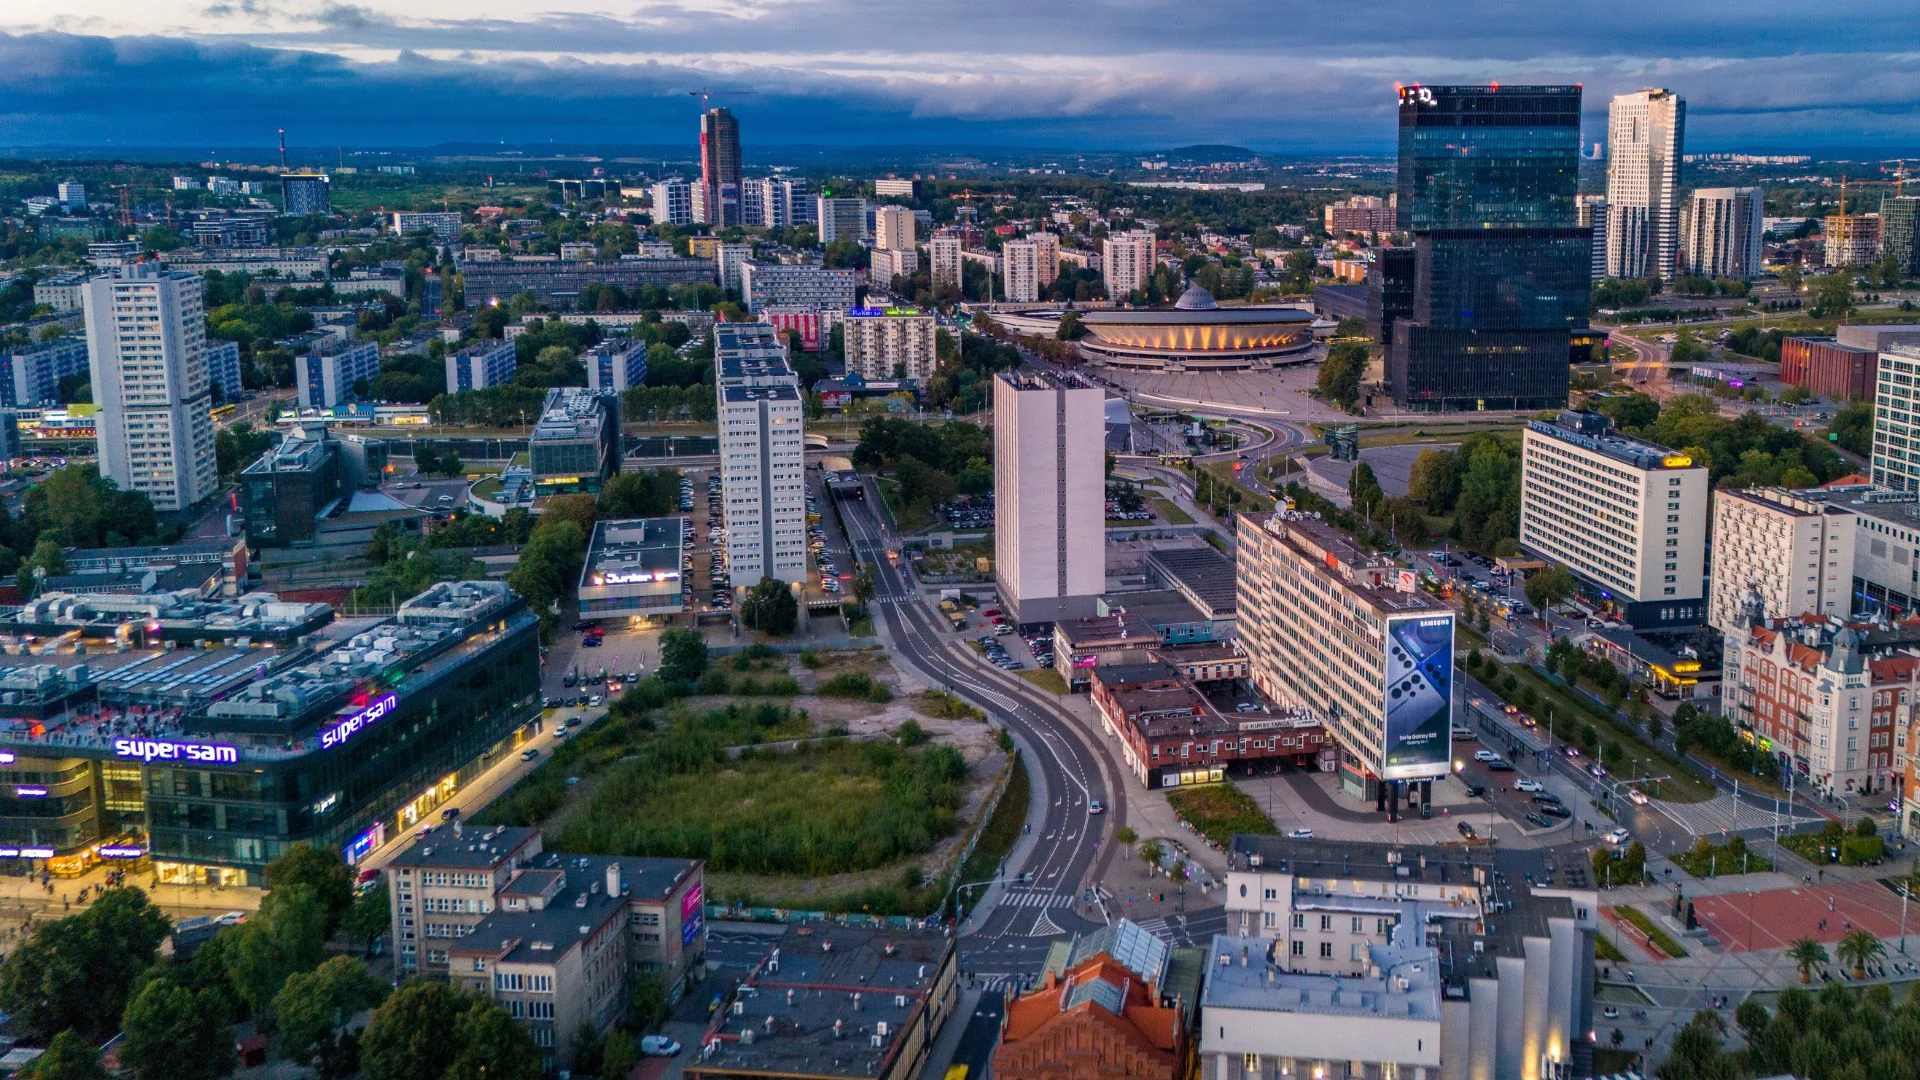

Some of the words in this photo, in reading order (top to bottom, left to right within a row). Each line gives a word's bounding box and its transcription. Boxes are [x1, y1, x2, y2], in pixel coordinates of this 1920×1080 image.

[1528, 420, 1551, 433] HOTEL
[1420, 619, 1449, 627] SAMSUNG
[323, 695, 396, 749] supersam
[115, 740, 237, 762] supersam
